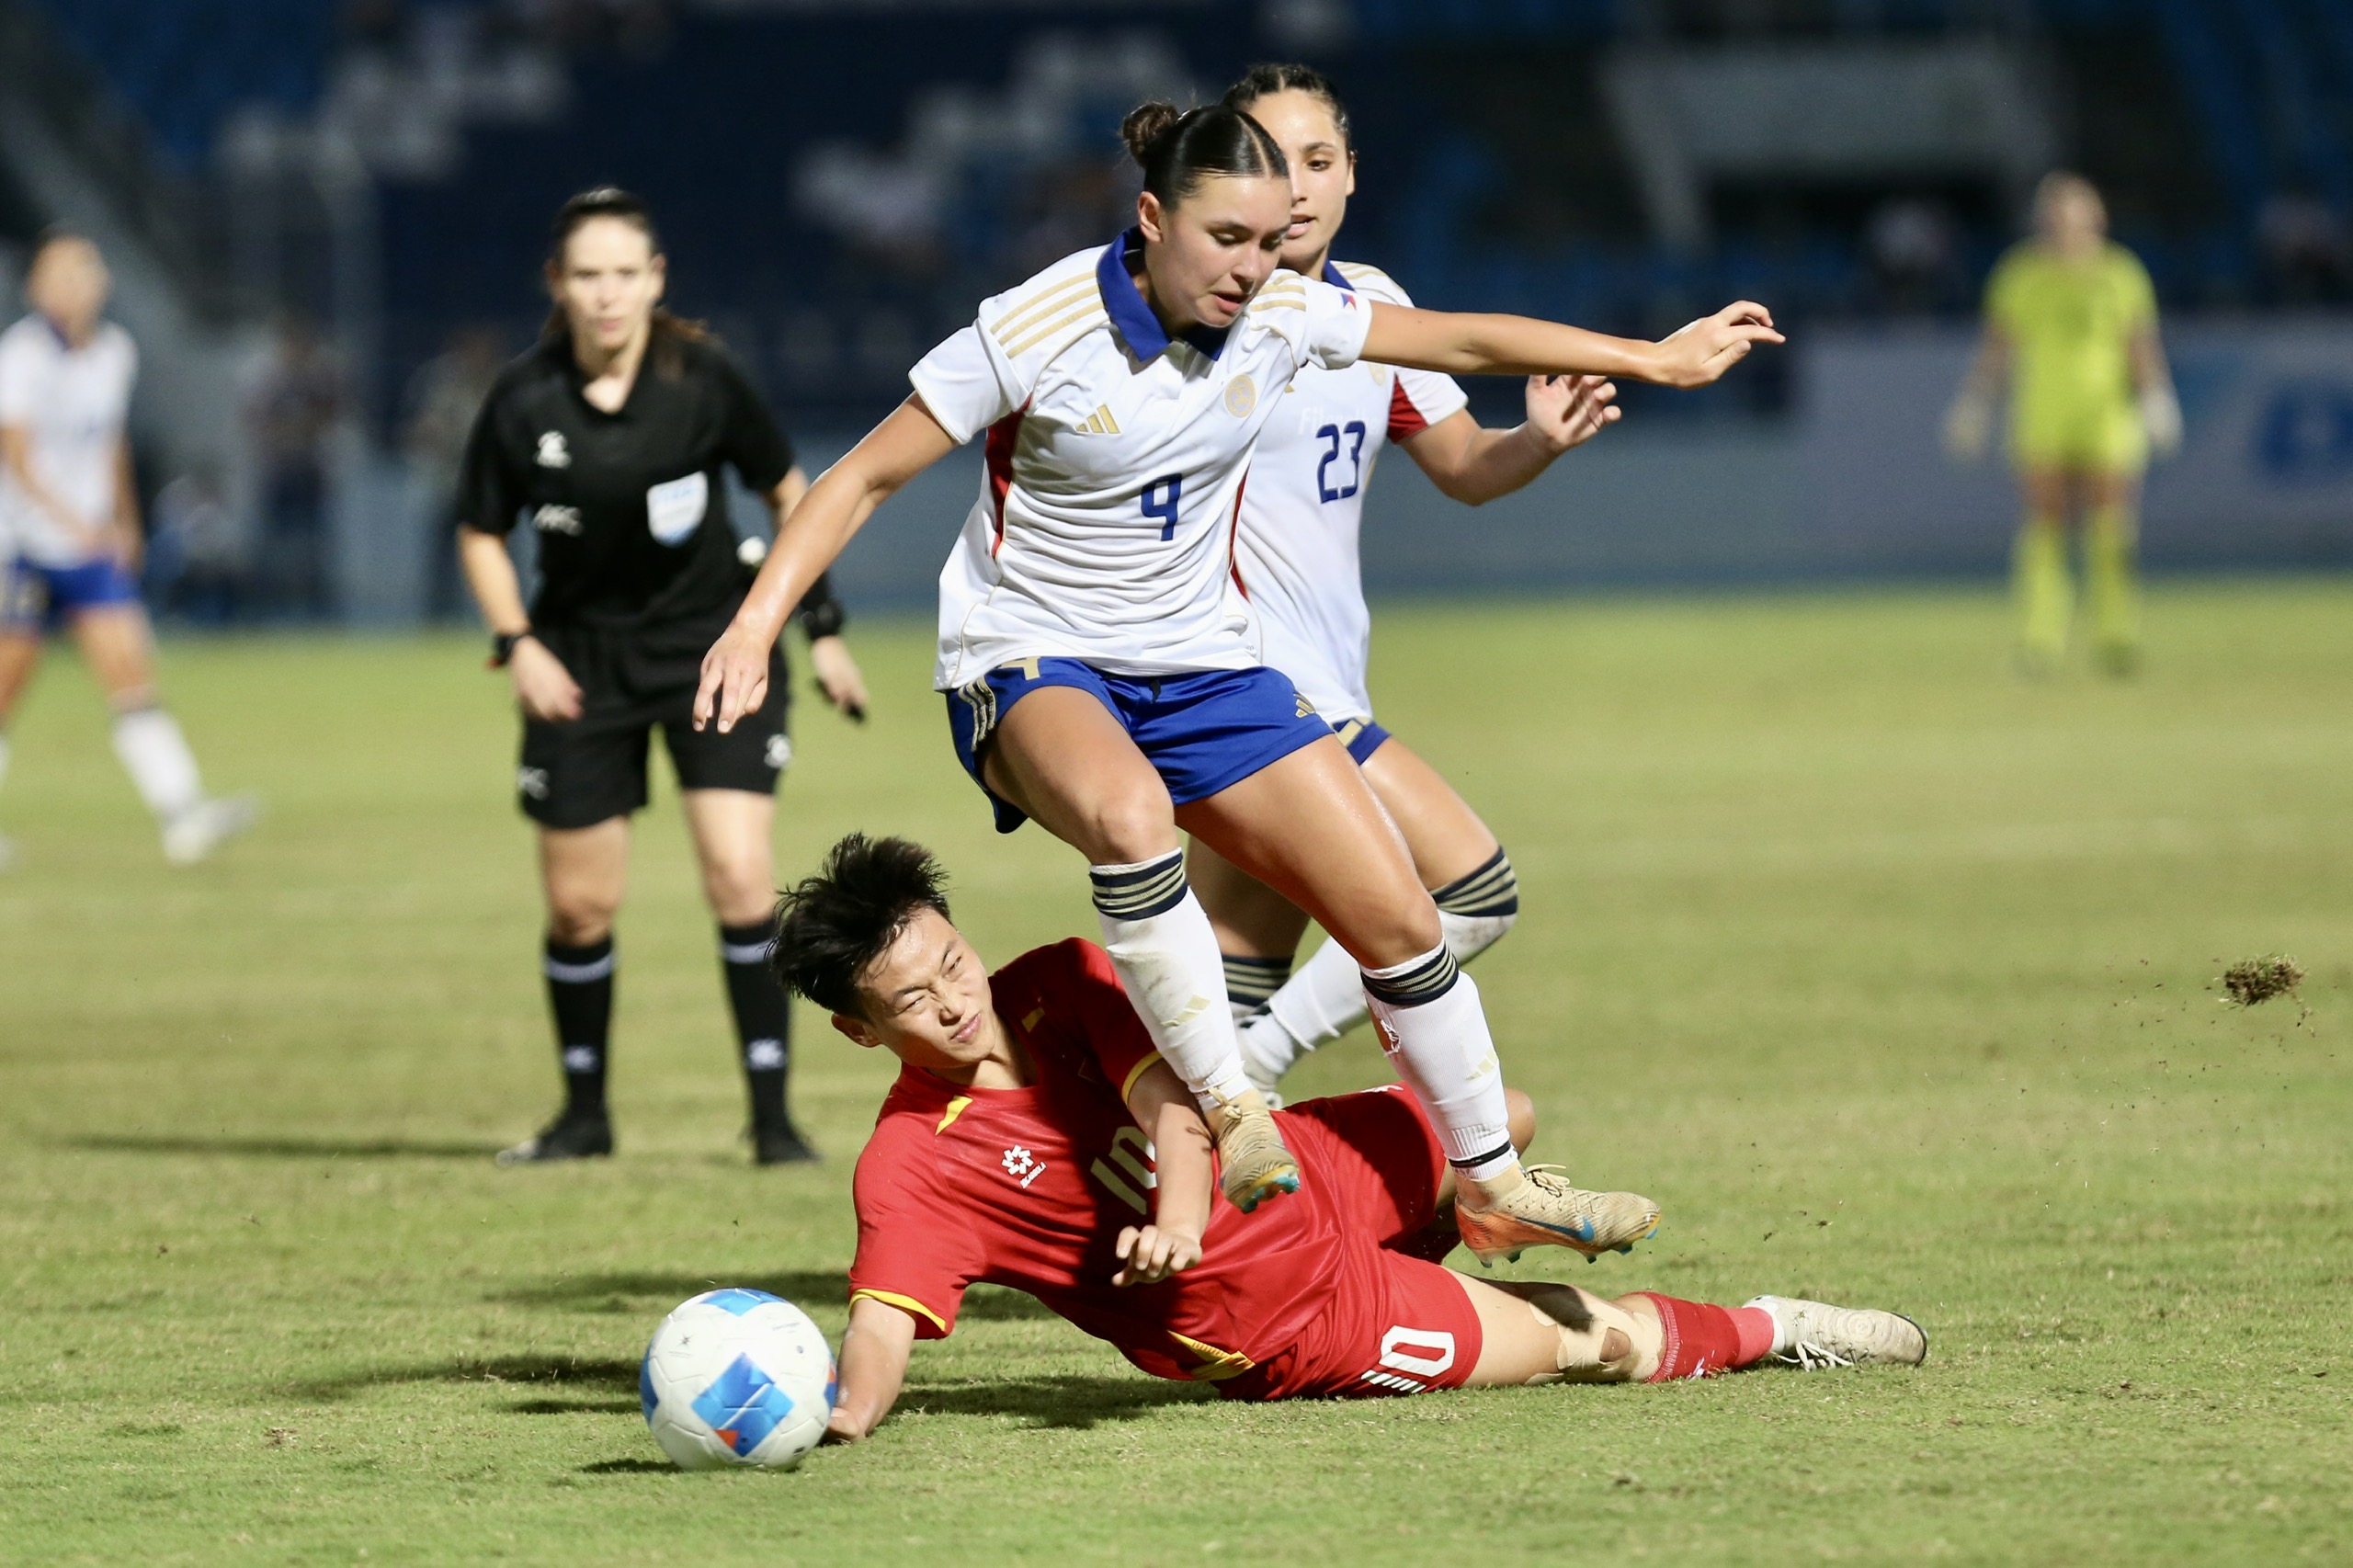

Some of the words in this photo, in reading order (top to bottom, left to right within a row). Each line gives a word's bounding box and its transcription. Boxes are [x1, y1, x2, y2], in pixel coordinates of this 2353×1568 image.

[1315, 420, 1366, 504] 23
[1141, 472, 1182, 541] 9
[1090, 1126, 1157, 1215] 10
